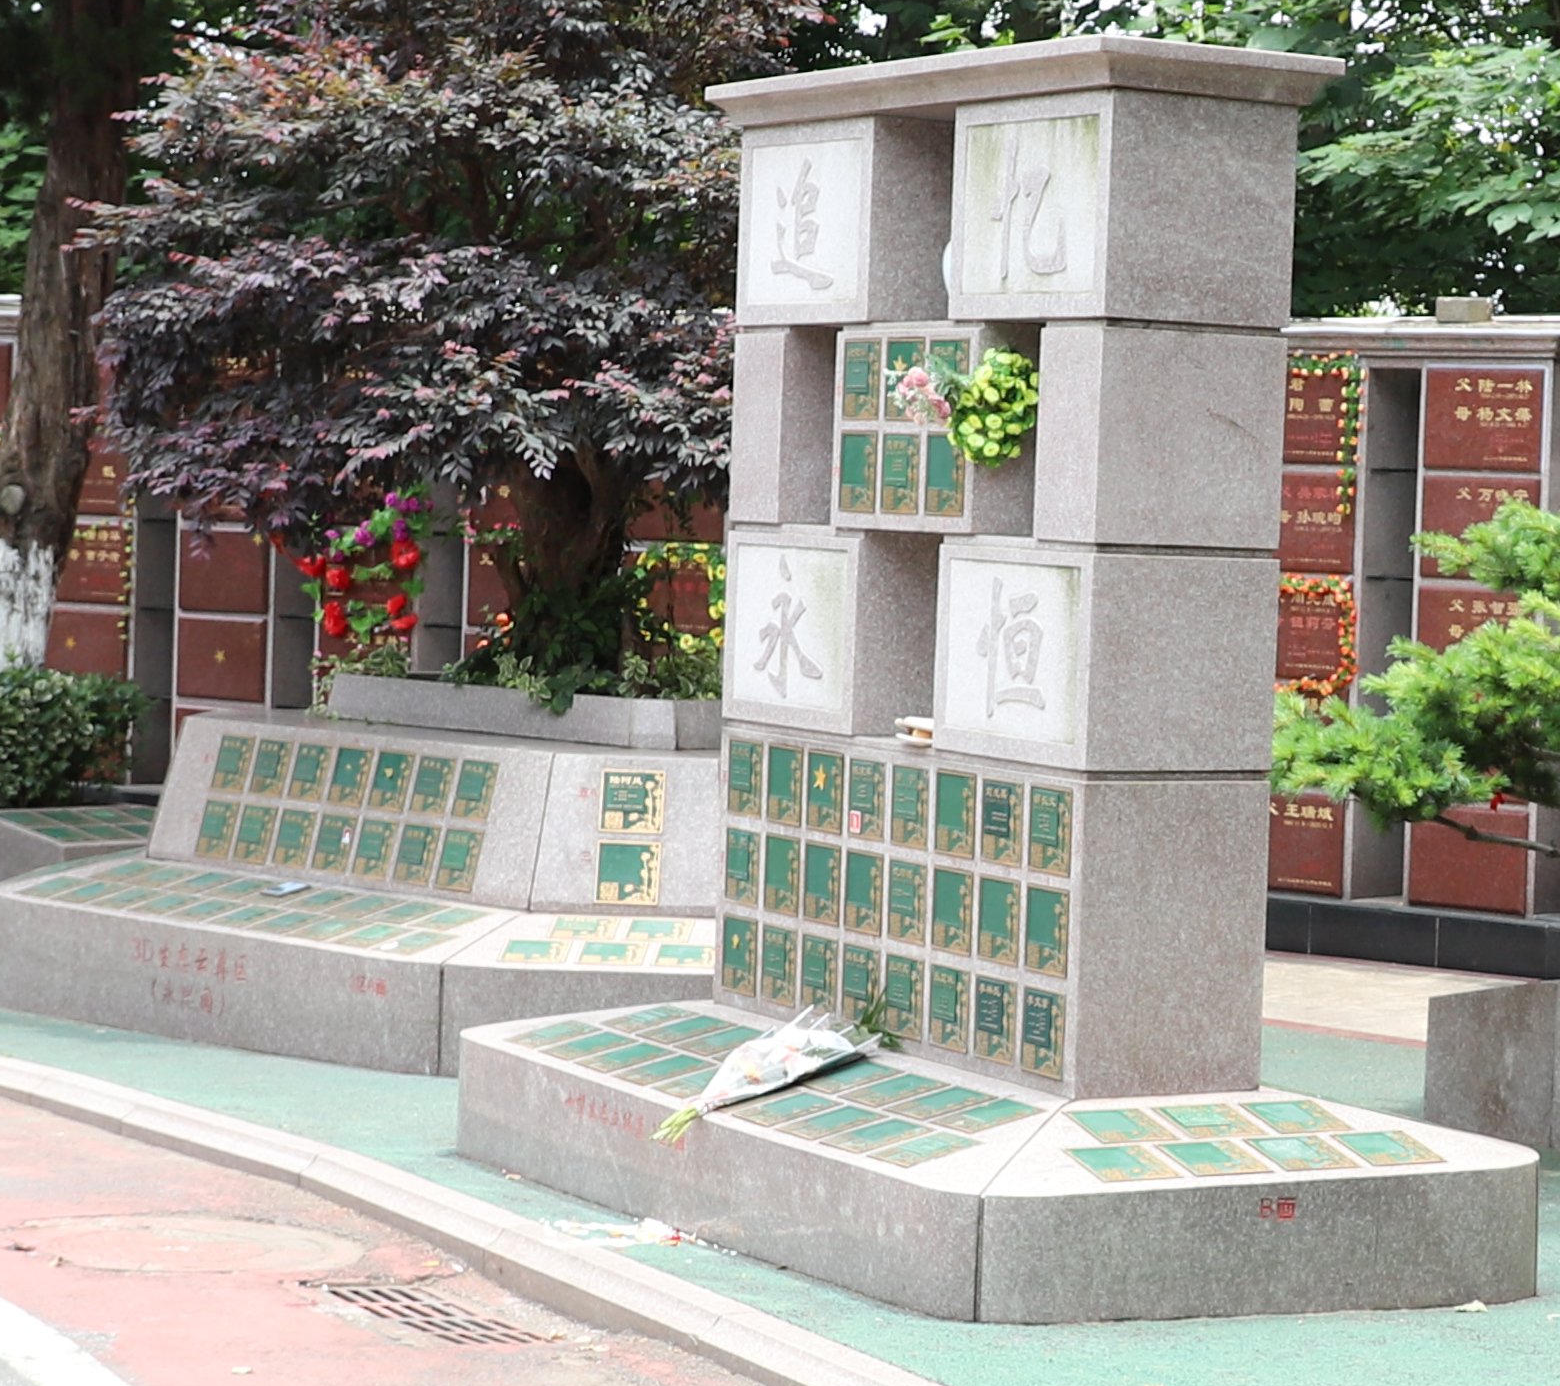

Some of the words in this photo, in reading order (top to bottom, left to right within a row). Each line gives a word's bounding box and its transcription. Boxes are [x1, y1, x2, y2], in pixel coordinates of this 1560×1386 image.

[771, 156, 833, 290] 追
[990, 131, 1068, 282] 忆
[1454, 377, 1473, 393] 父
[1455, 487, 1473, 501] 父
[1448, 598, 1465, 613] 父
[754, 555, 823, 701] 永
[977, 576, 1046, 719] 恒
[1258, 1197, 1298, 1223] B面
